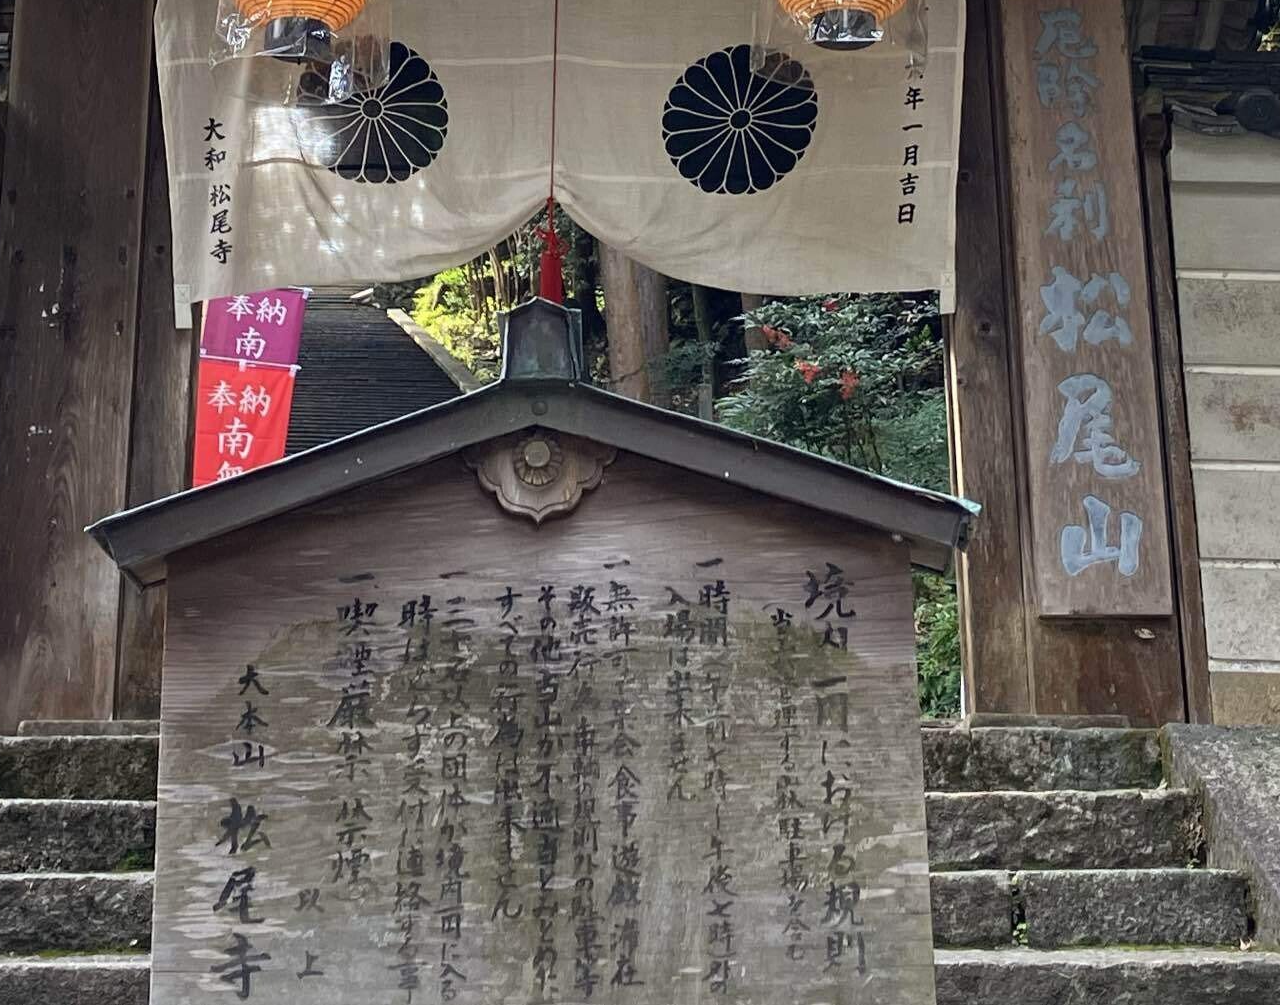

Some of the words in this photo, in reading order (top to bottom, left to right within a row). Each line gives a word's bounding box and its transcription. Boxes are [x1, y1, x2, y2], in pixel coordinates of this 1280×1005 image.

[226, 295, 288, 326] 奉納
[235, 327, 266, 359] 南
[207, 380, 272, 417] 奉納
[210, 797, 272, 1001] 松尾寺
